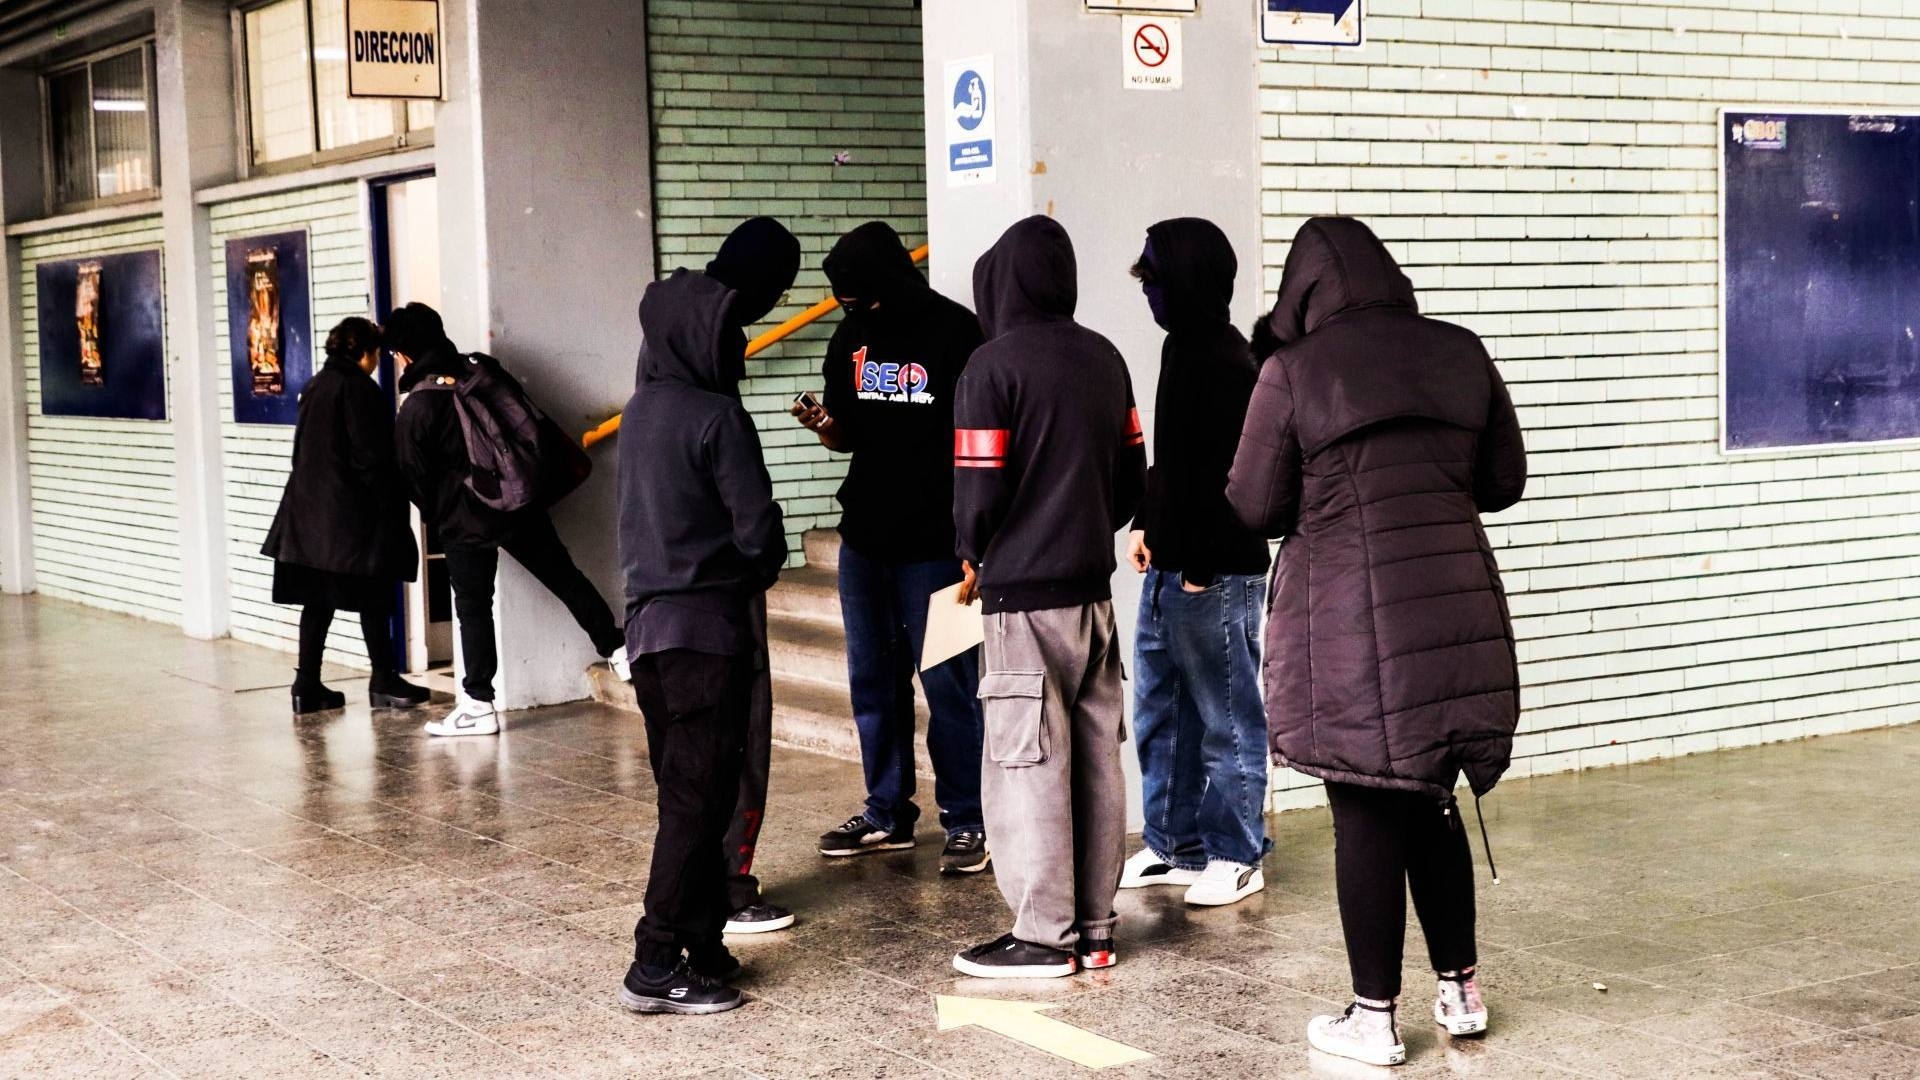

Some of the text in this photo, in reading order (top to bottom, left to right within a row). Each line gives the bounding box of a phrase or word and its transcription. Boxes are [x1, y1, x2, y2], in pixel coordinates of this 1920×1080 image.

[354, 30, 434, 64] DIRECCION
[1131, 76, 1172, 84] NO FUMAR
